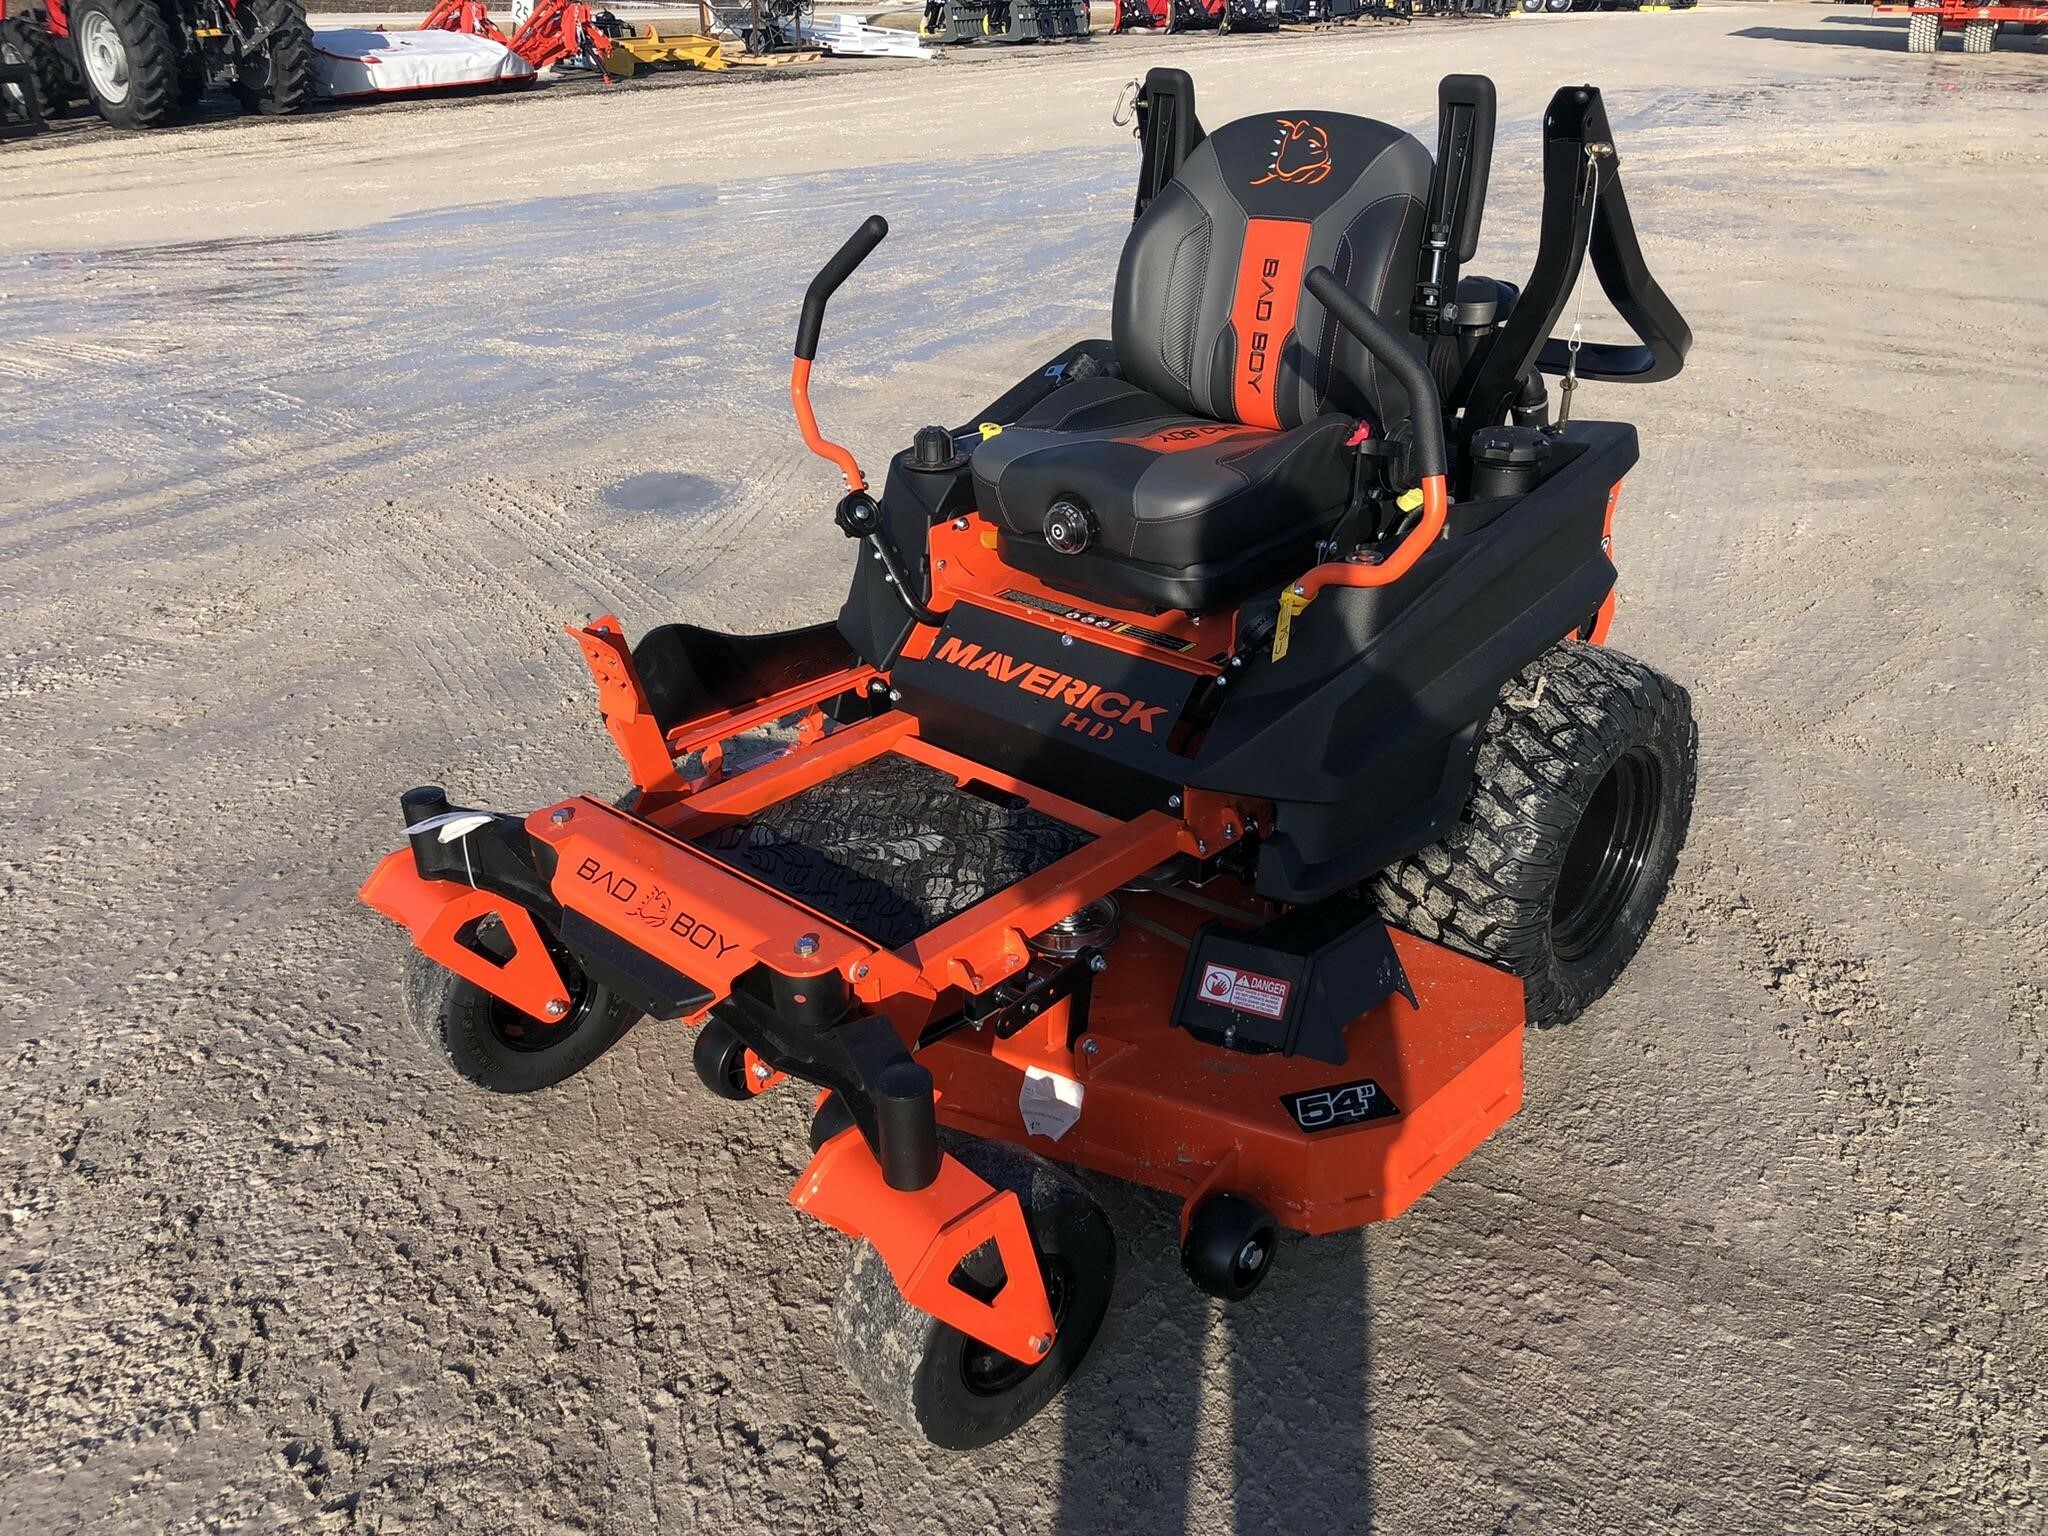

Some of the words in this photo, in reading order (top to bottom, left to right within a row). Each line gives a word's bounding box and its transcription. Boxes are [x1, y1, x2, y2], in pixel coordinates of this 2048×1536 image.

[515, 1, 530, 23] 25
[1256, 258, 1280, 321] BAD
[1247, 332, 1268, 394] BOY
[1158, 429, 1199, 442] BOY
[935, 637, 1168, 733] MAVERICK
[1061, 711, 1114, 740] HD
[576, 857, 637, 902] BAD
[670, 912, 740, 959] BOY
[1251, 977, 1286, 996] DANGER
